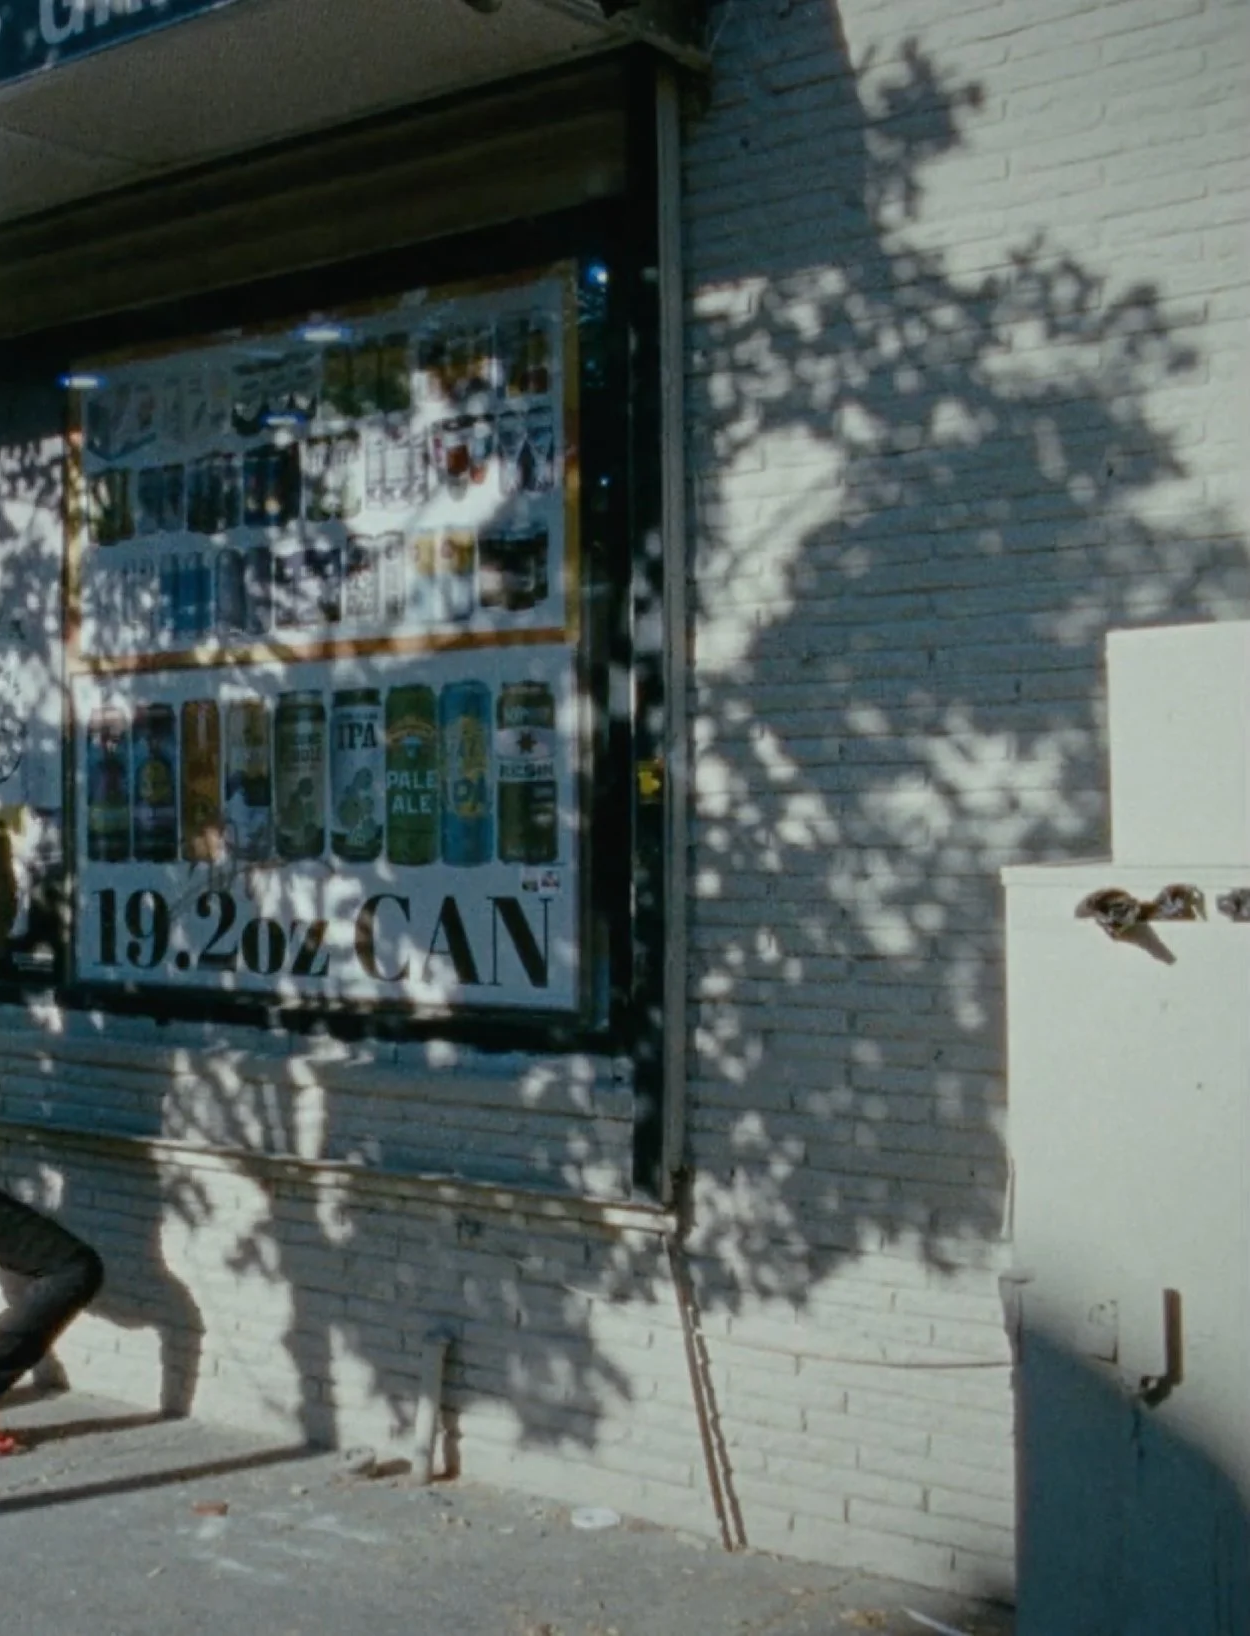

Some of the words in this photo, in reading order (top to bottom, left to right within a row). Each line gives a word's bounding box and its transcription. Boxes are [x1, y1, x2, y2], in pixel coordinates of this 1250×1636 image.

[338, 722, 379, 750] IPA
[386, 770, 438, 791] PALE
[392, 795, 432, 815] ALE
[92, 887, 330, 977] 19.2oz
[354, 893, 553, 988] CAN
